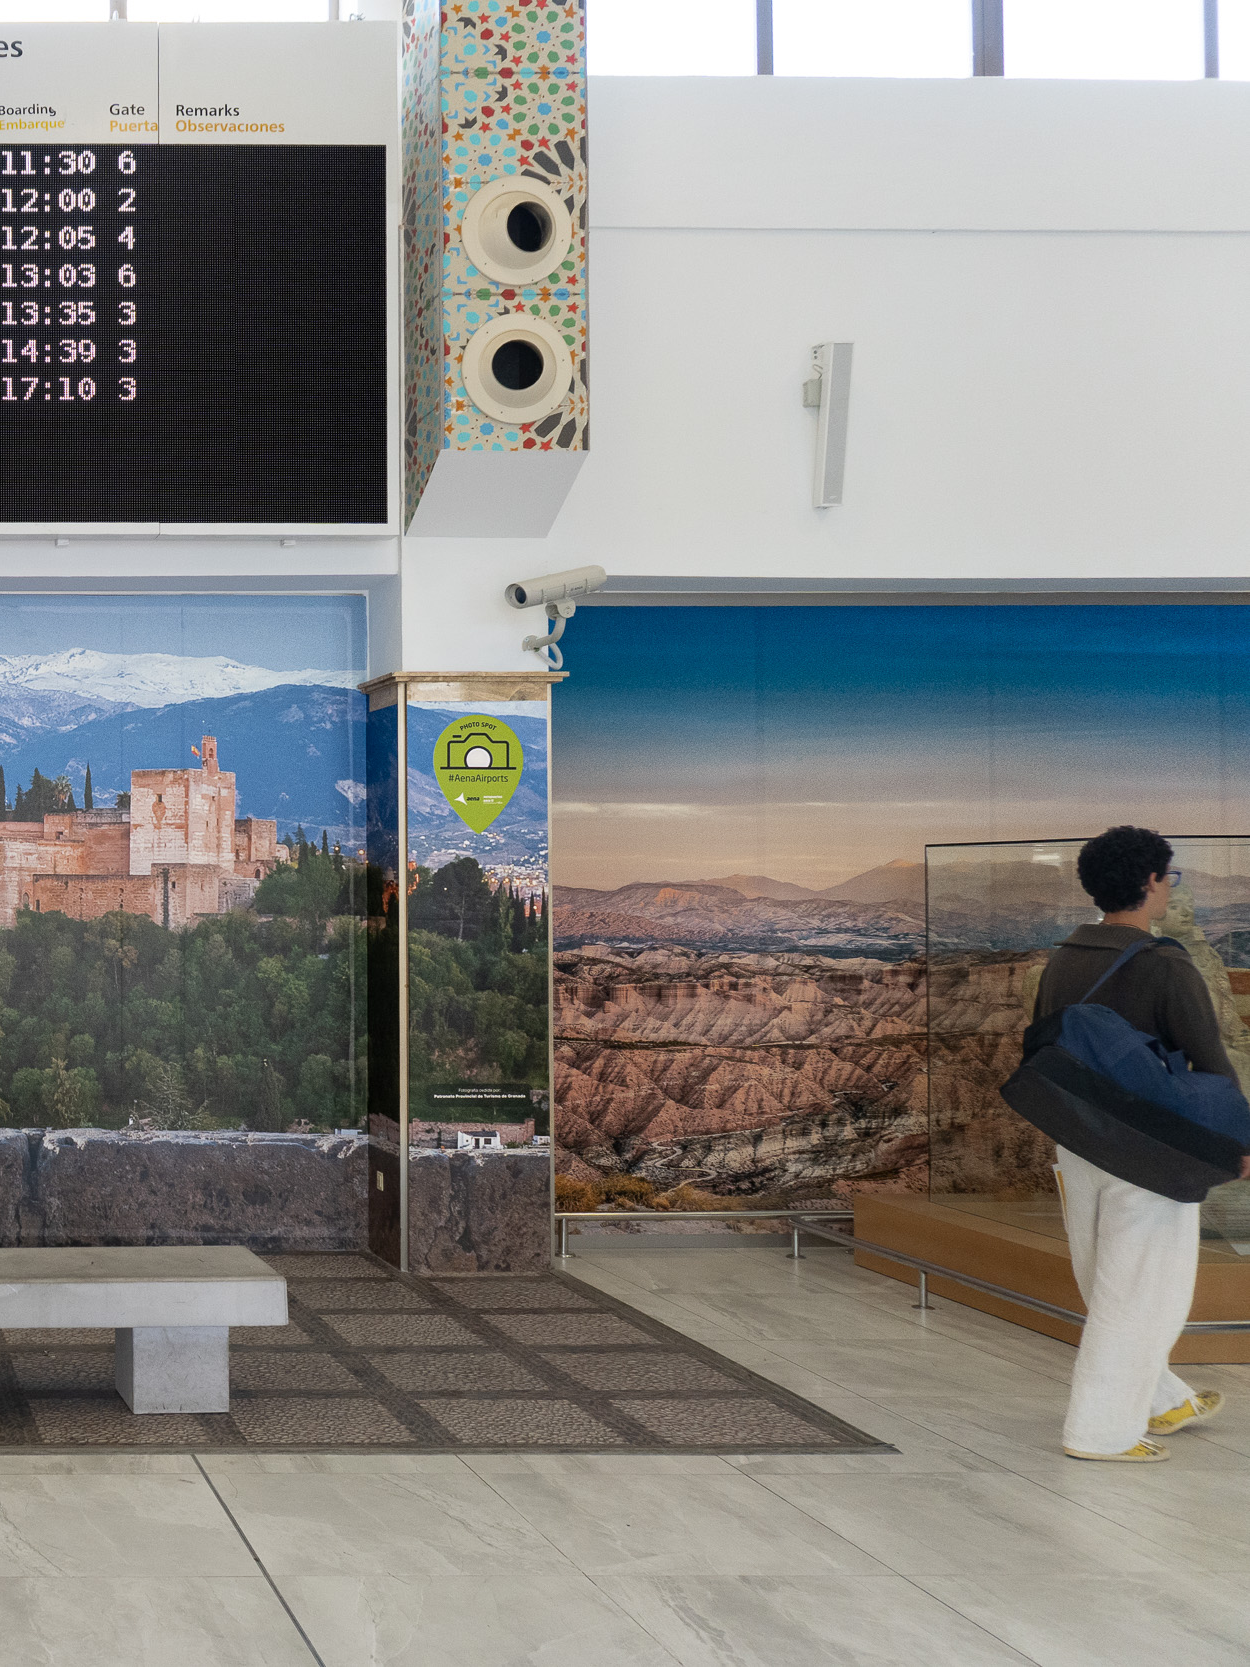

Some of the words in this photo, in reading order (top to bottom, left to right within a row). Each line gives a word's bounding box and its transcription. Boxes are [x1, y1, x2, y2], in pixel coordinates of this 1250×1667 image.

[0, 104, 56, 116] Boarding
[110, 104, 144, 115] Gate
[176, 104, 239, 116] Remarks
[0, 118, 65, 131] Embarque
[109, 120, 158, 133] Puerta
[176, 120, 284, 132] Observaciones
[2, 151, 95, 175] 11:30
[119, 151, 135, 174] 6
[2, 188, 95, 212] 12:00
[119, 188, 135, 212] 2
[2, 226, 95, 250] 12:05
[119, 226, 135, 249] 4
[3, 264, 95, 287] 13:03
[119, 264, 135, 287] 6
[3, 302, 95, 325] 13:35
[119, 302, 135, 325] 3
[2, 340, 95, 362] 14:39
[119, 340, 136, 363] 3
[3, 377, 95, 400] 17:10
[119, 378, 136, 400] 3
[460, 722, 480, 731] PHOTO
[481, 722, 497, 731] SPOT
[449, 774, 508, 783] #AenaAirports
